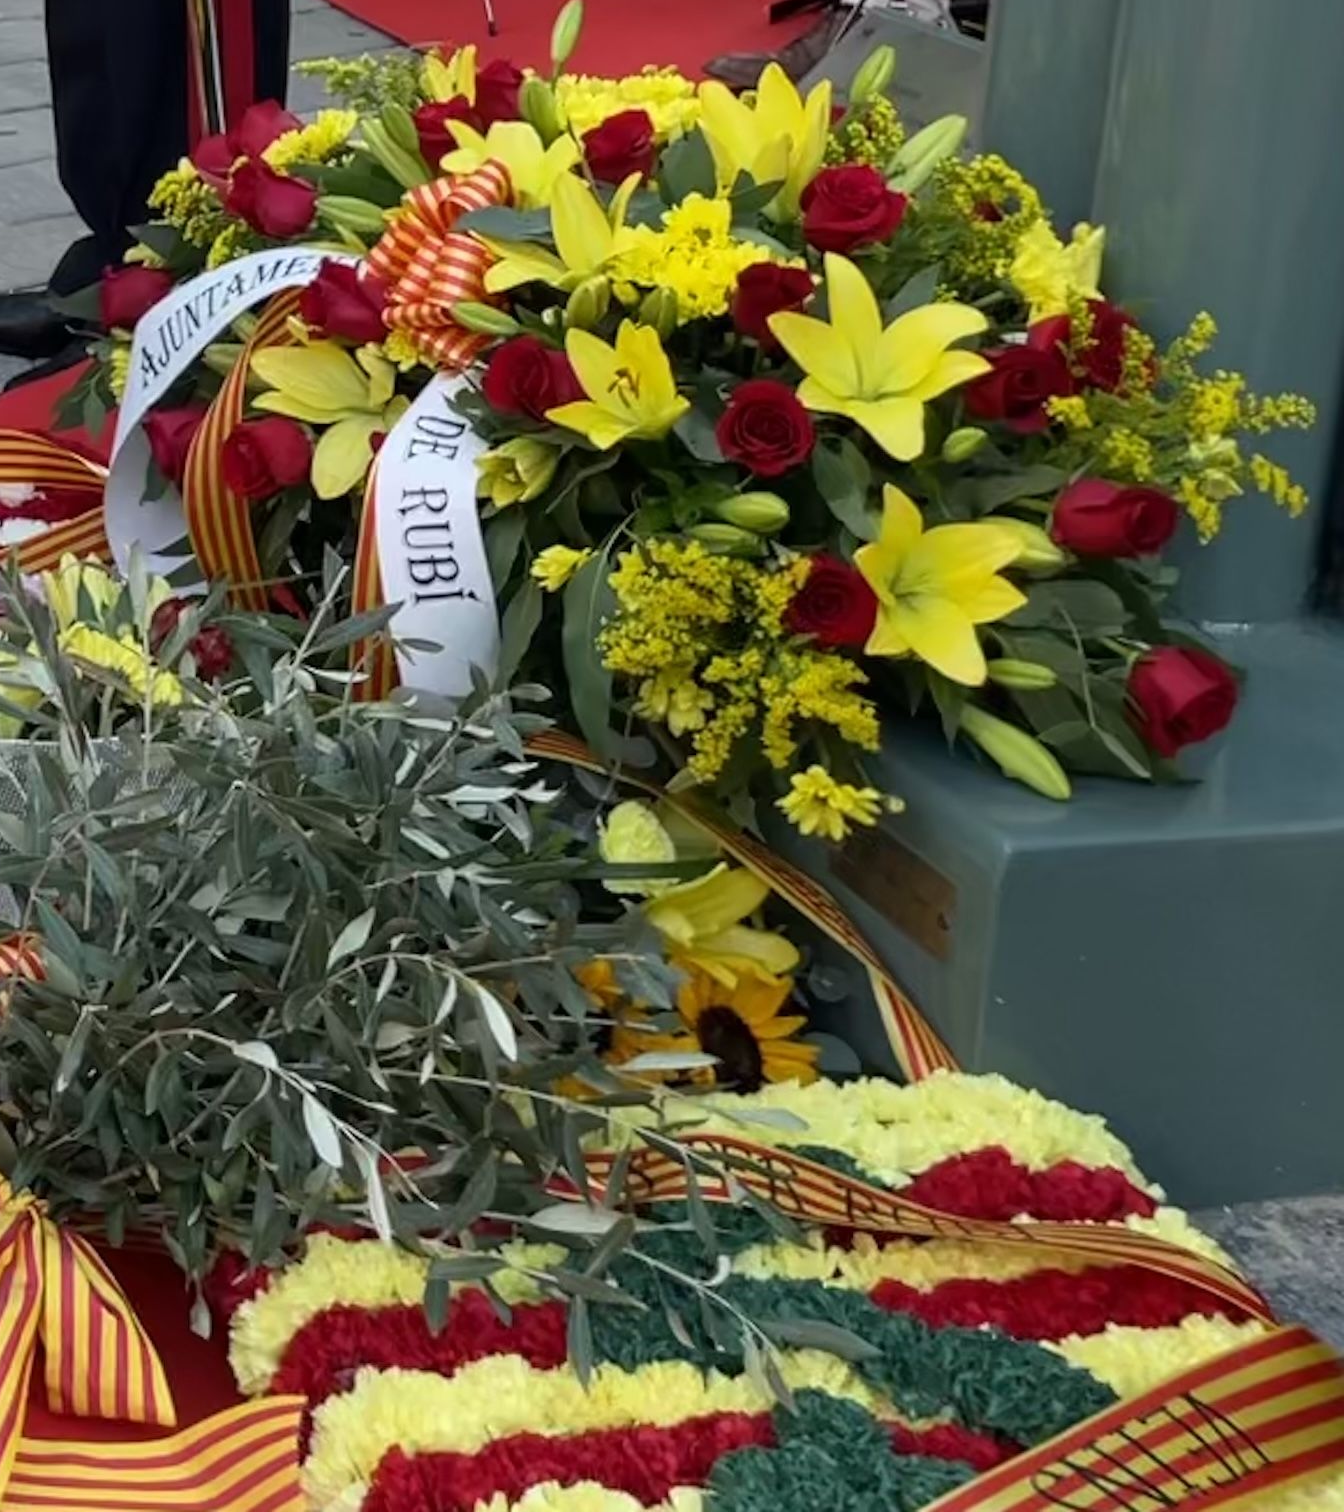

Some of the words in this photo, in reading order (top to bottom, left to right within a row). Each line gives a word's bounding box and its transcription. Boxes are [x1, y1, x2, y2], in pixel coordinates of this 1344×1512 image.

[140, 255, 322, 388] AJUNTAME
[405, 415, 468, 463] DE
[398, 486, 488, 608] RUBÍ
